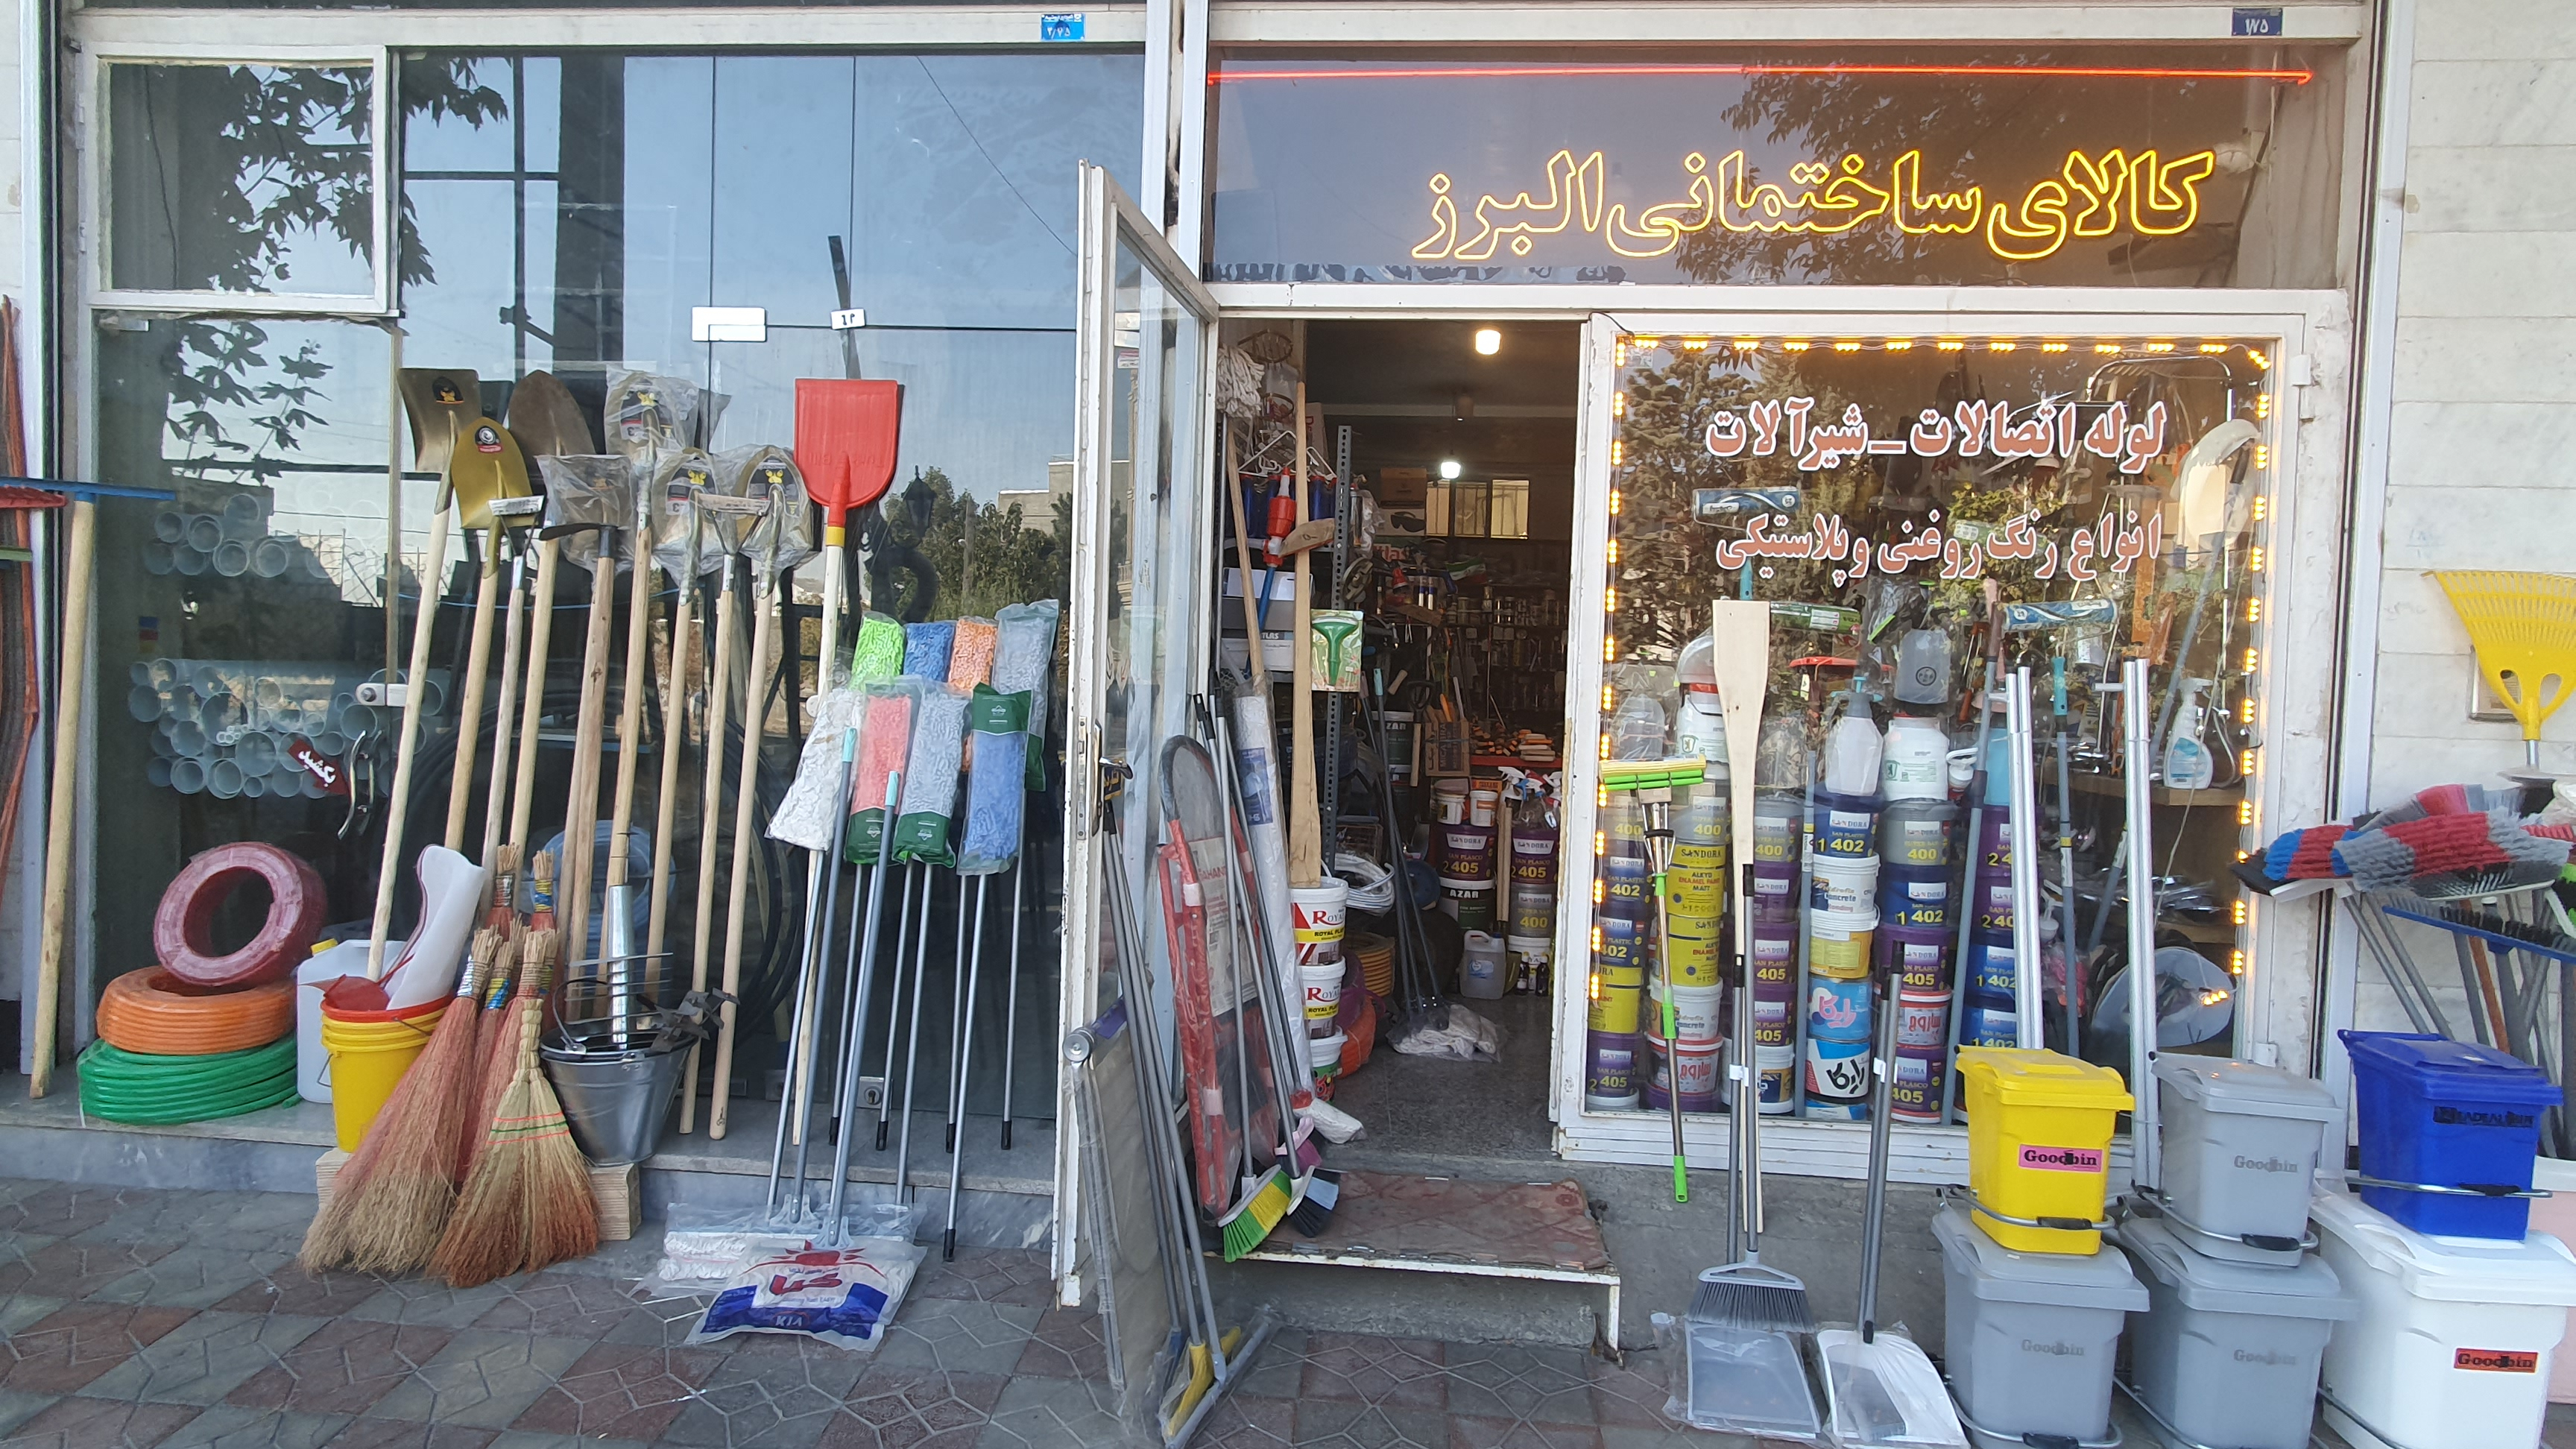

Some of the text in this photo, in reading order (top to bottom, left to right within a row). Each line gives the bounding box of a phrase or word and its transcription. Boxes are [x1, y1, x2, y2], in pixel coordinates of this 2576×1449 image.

[1411, 148, 2214, 260] کالای ساختمانی البرز
[1909, 398, 2076, 458] اتصالات
[2085, 398, 2167, 475] لوله
[1877, 508, 1983, 579] روغنی
[1986, 508, 2059, 579] رنگ
[2067, 510, 2163, 581] انواع
[298, 749, 338, 787] بکشید
[1693, 824, 1722, 836] 400
[1755, 844, 1783, 856] 400
[1830, 838, 1865, 853] 402
[1681, 848, 1722, 858] SANDORA
[1907, 848, 1937, 859] 400
[1450, 861, 1479, 874] 405
[1518, 865, 1547, 878] 405
[1449, 888, 1479, 899] AZAR
[1611, 883, 1641, 896] 402
[1520, 916, 1548, 928] 400
[1911, 909, 1943, 923] 402
[1994, 915, 2014, 928] 40
[1756, 967, 1786, 981] 405
[1902, 972, 1935, 985] 405
[1755, 1029, 1782, 1042] 405
[1600, 1076, 1627, 1087] 405
[1892, 1087, 1924, 1103] 405
[775, 1315, 803, 1328] KIA
